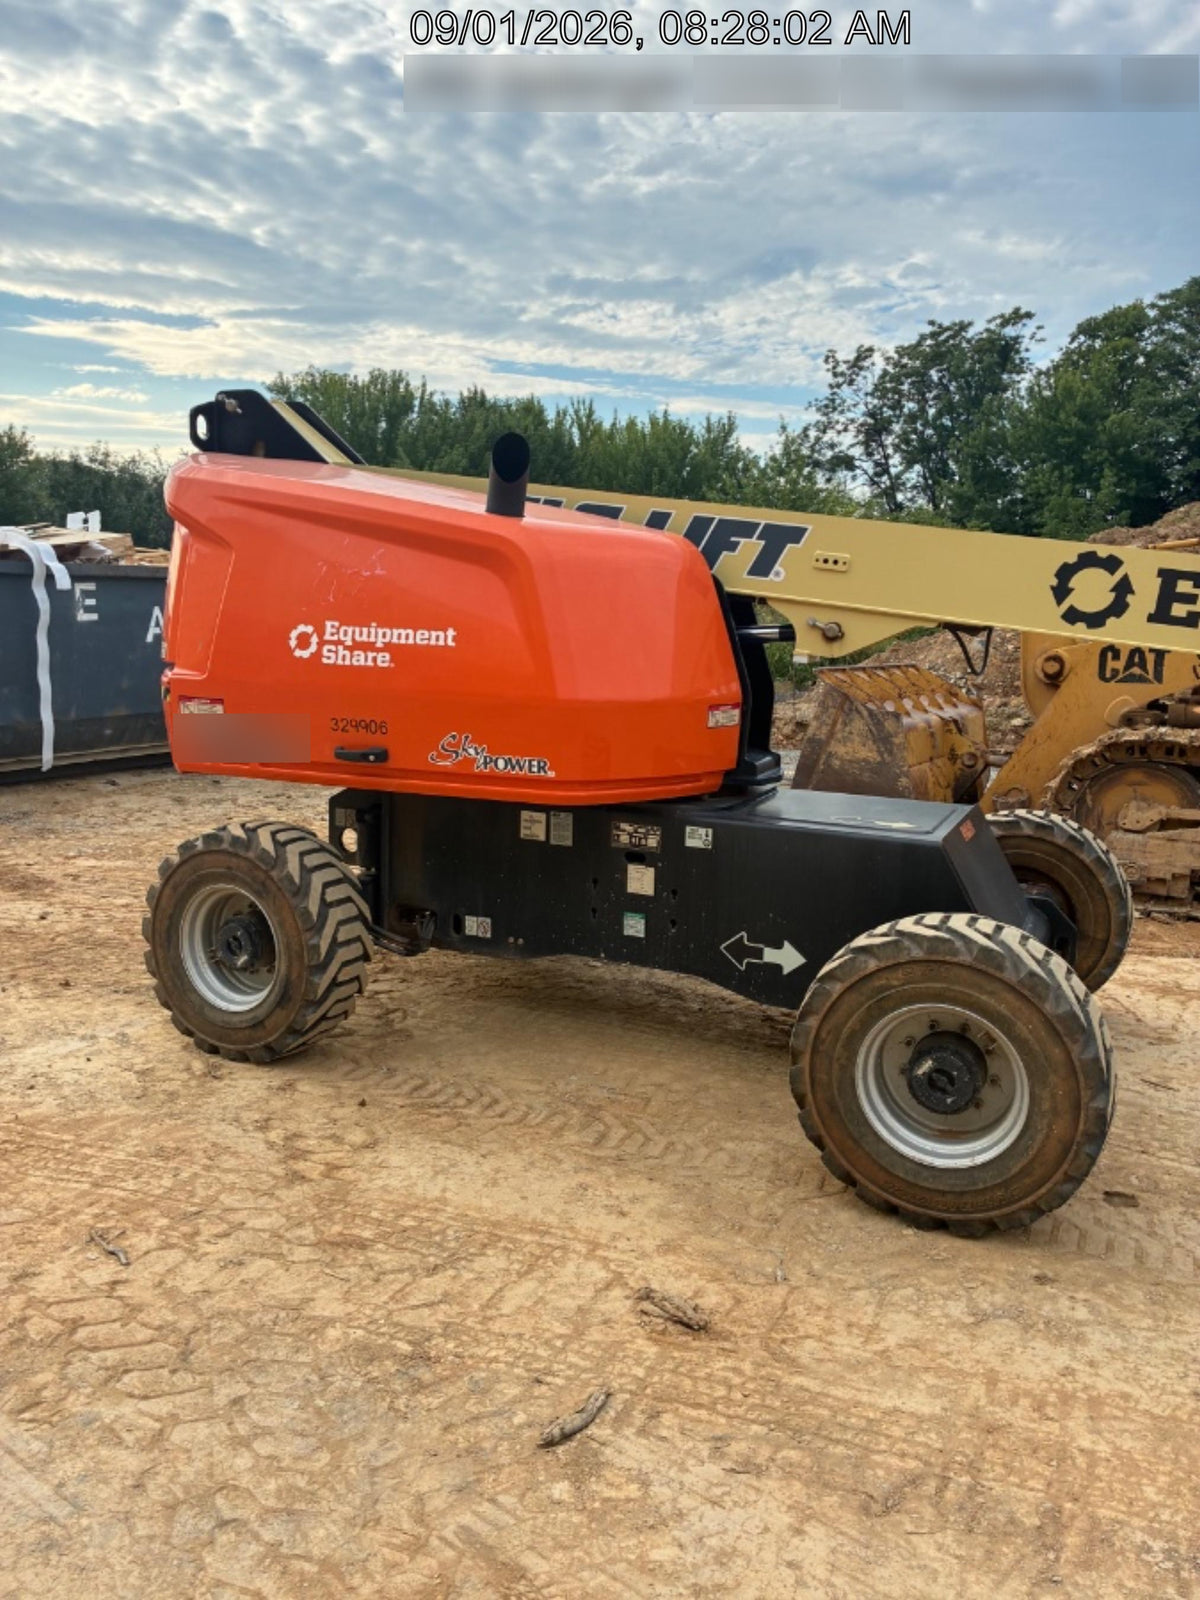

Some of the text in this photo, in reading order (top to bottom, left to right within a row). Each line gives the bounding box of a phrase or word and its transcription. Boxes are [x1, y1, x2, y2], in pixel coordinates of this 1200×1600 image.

[323, 620, 457, 648] Equipment
[1097, 644, 1171, 685] CAT
[428, 732, 549, 777] Sky POWER
